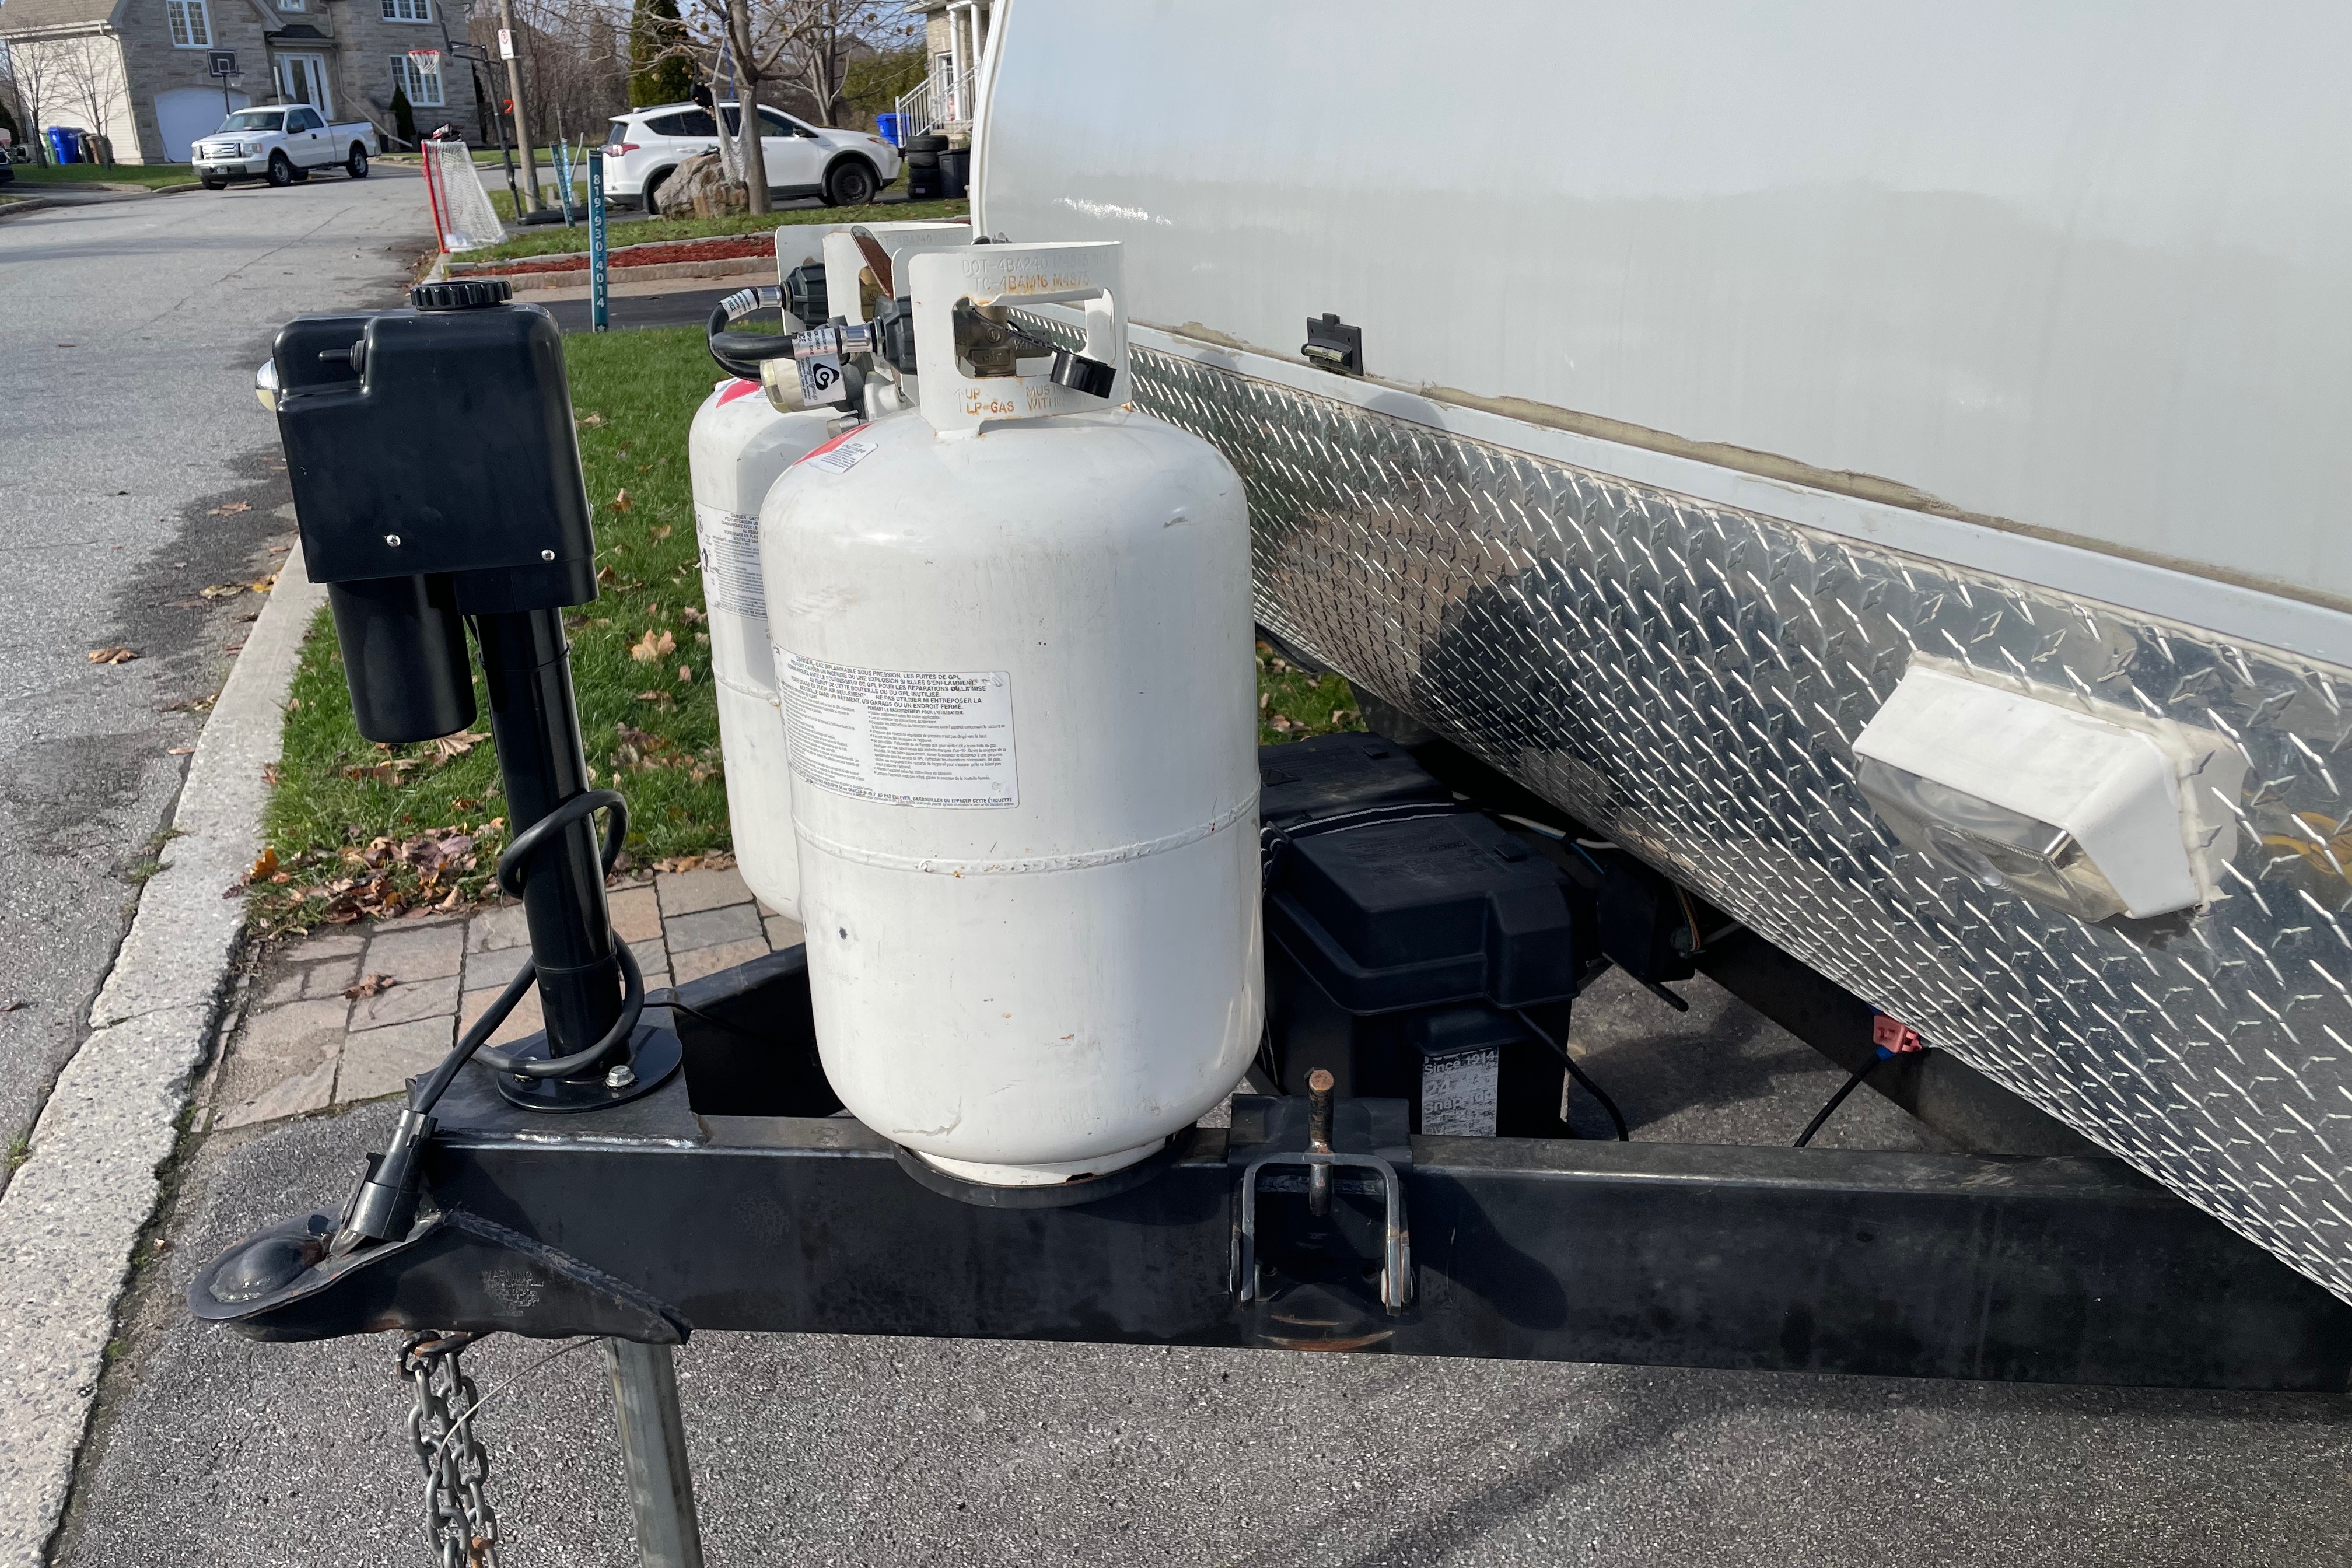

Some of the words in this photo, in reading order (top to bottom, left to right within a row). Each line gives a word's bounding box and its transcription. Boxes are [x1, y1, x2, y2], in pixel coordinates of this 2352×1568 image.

[963, 257, 1048, 275] DOT-4BA240
[965, 387, 981, 400] UP
[966, 400, 1015, 416] LP-GAS
[868, 676, 899, 684] EXPLOSION
[851, 685, 878, 694] BOUTEILLE
[1424, 1059, 1461, 1075] Since
[1465, 1050, 1495, 1066] 1914
[482, 1269, 533, 1280] WARNING
